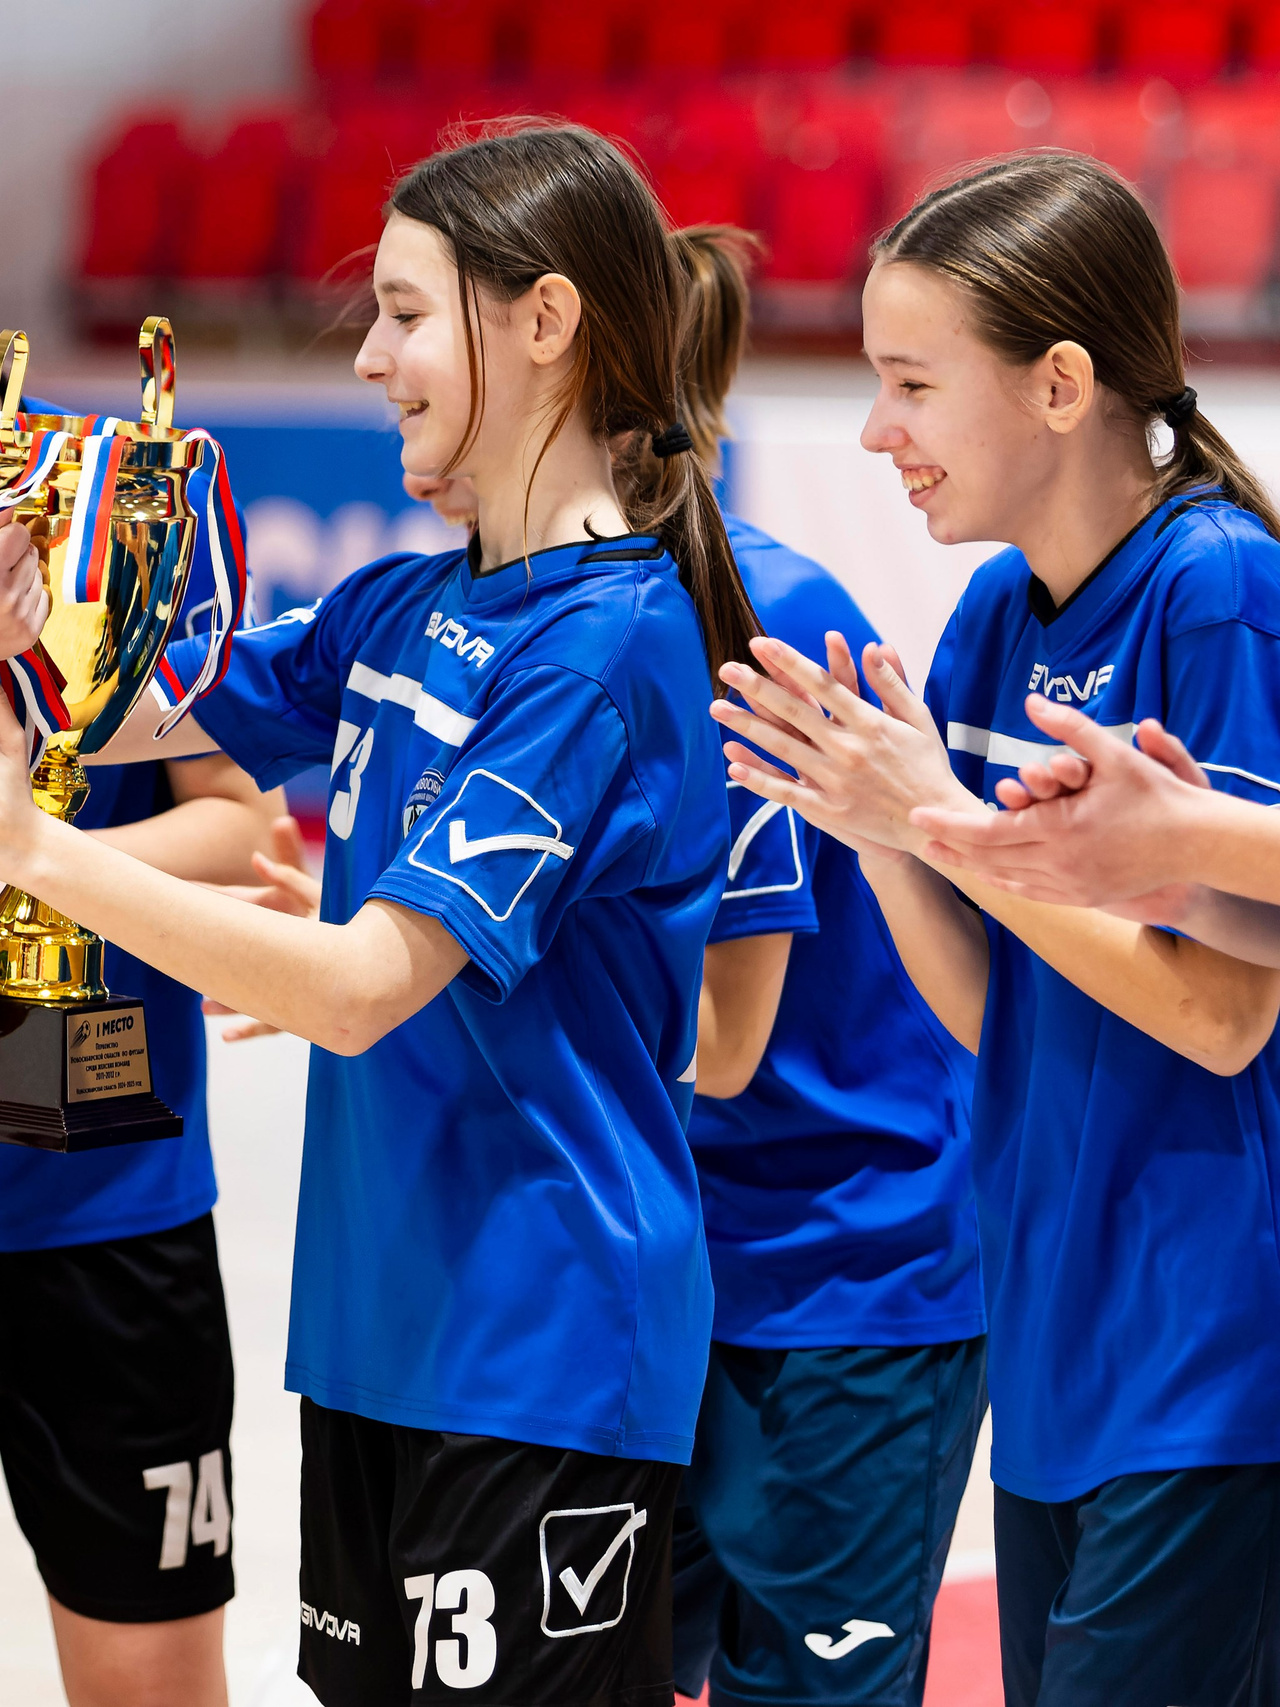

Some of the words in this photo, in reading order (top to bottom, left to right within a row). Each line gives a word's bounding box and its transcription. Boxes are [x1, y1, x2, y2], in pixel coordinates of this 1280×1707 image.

[424, 611, 495, 668] GVOVA
[102, 1015, 134, 1036] МЕСТО
[142, 1447, 232, 1570] 74
[300, 1600, 361, 1646] GIVOVA
[404, 1568, 498, 1690] 73
